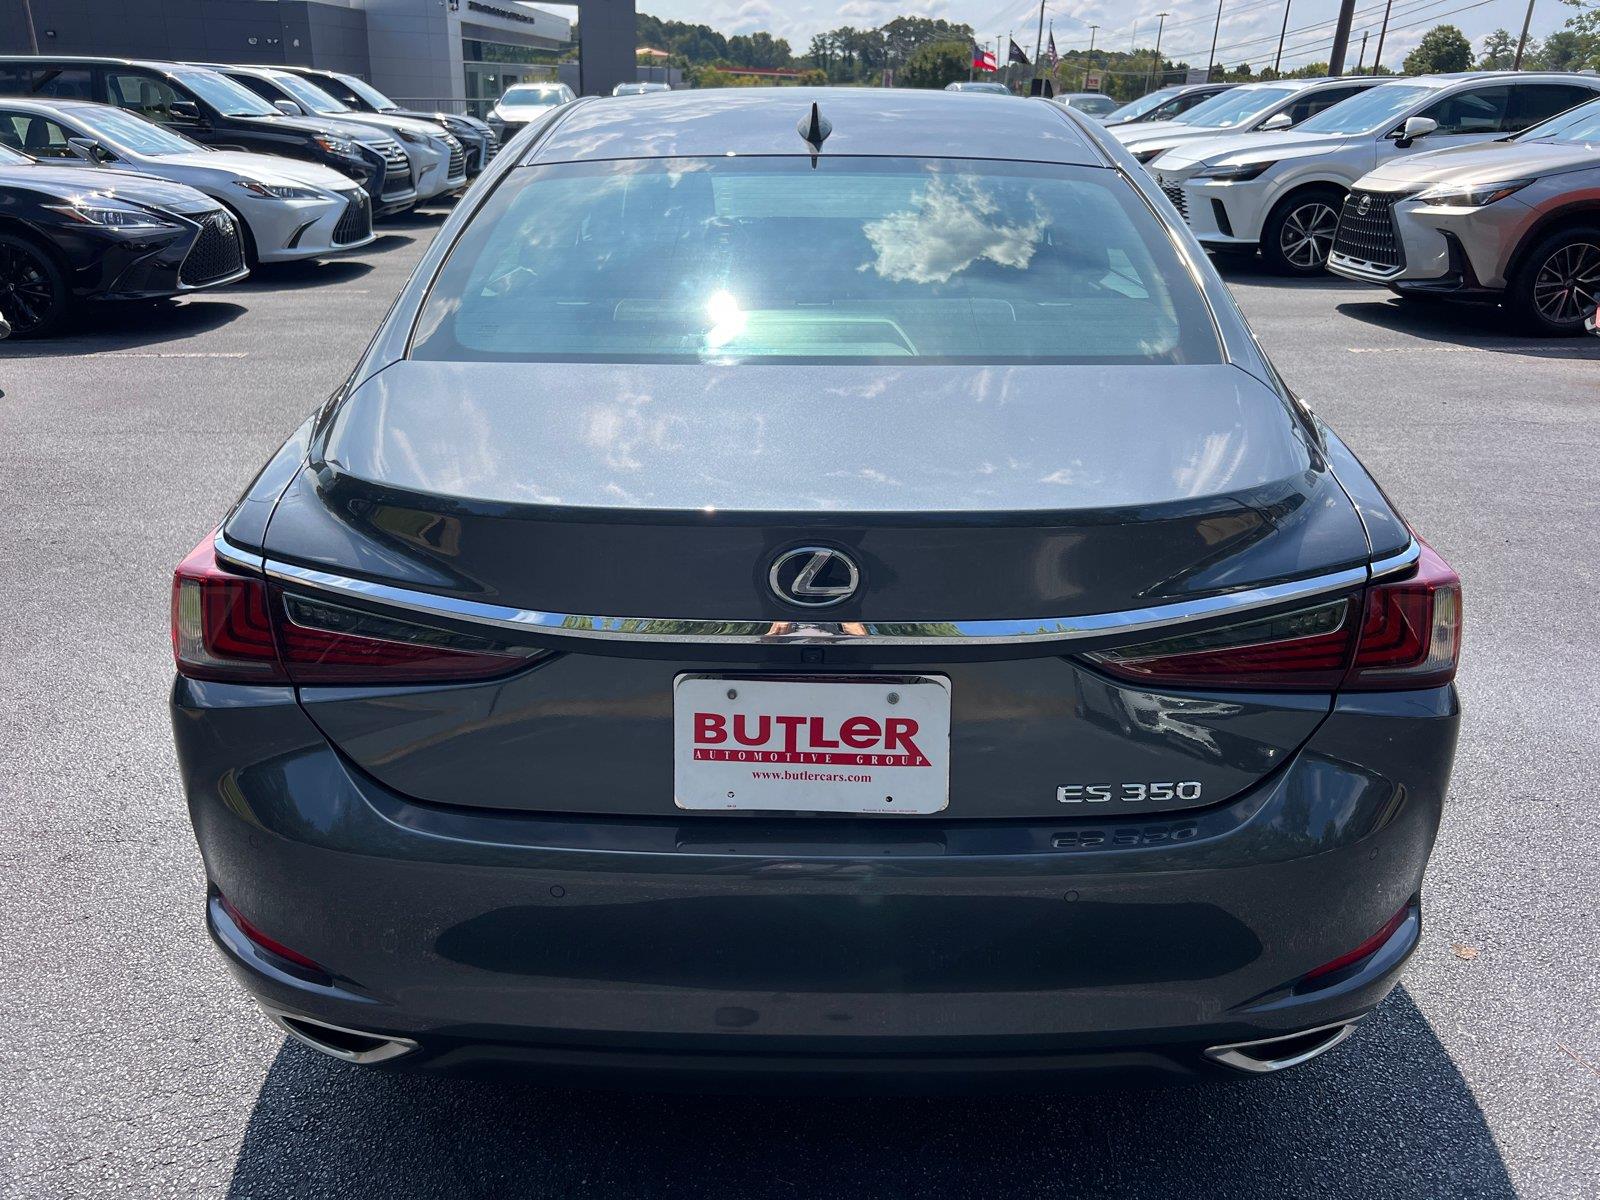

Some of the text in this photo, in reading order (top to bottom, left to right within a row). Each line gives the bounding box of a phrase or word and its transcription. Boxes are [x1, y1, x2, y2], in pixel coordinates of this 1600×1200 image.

[695, 750, 923, 766] AUTOMOTIVE GROUP
[752, 770, 872, 783] www.butlercars.com
[1056, 781, 1202, 803] ES 350
